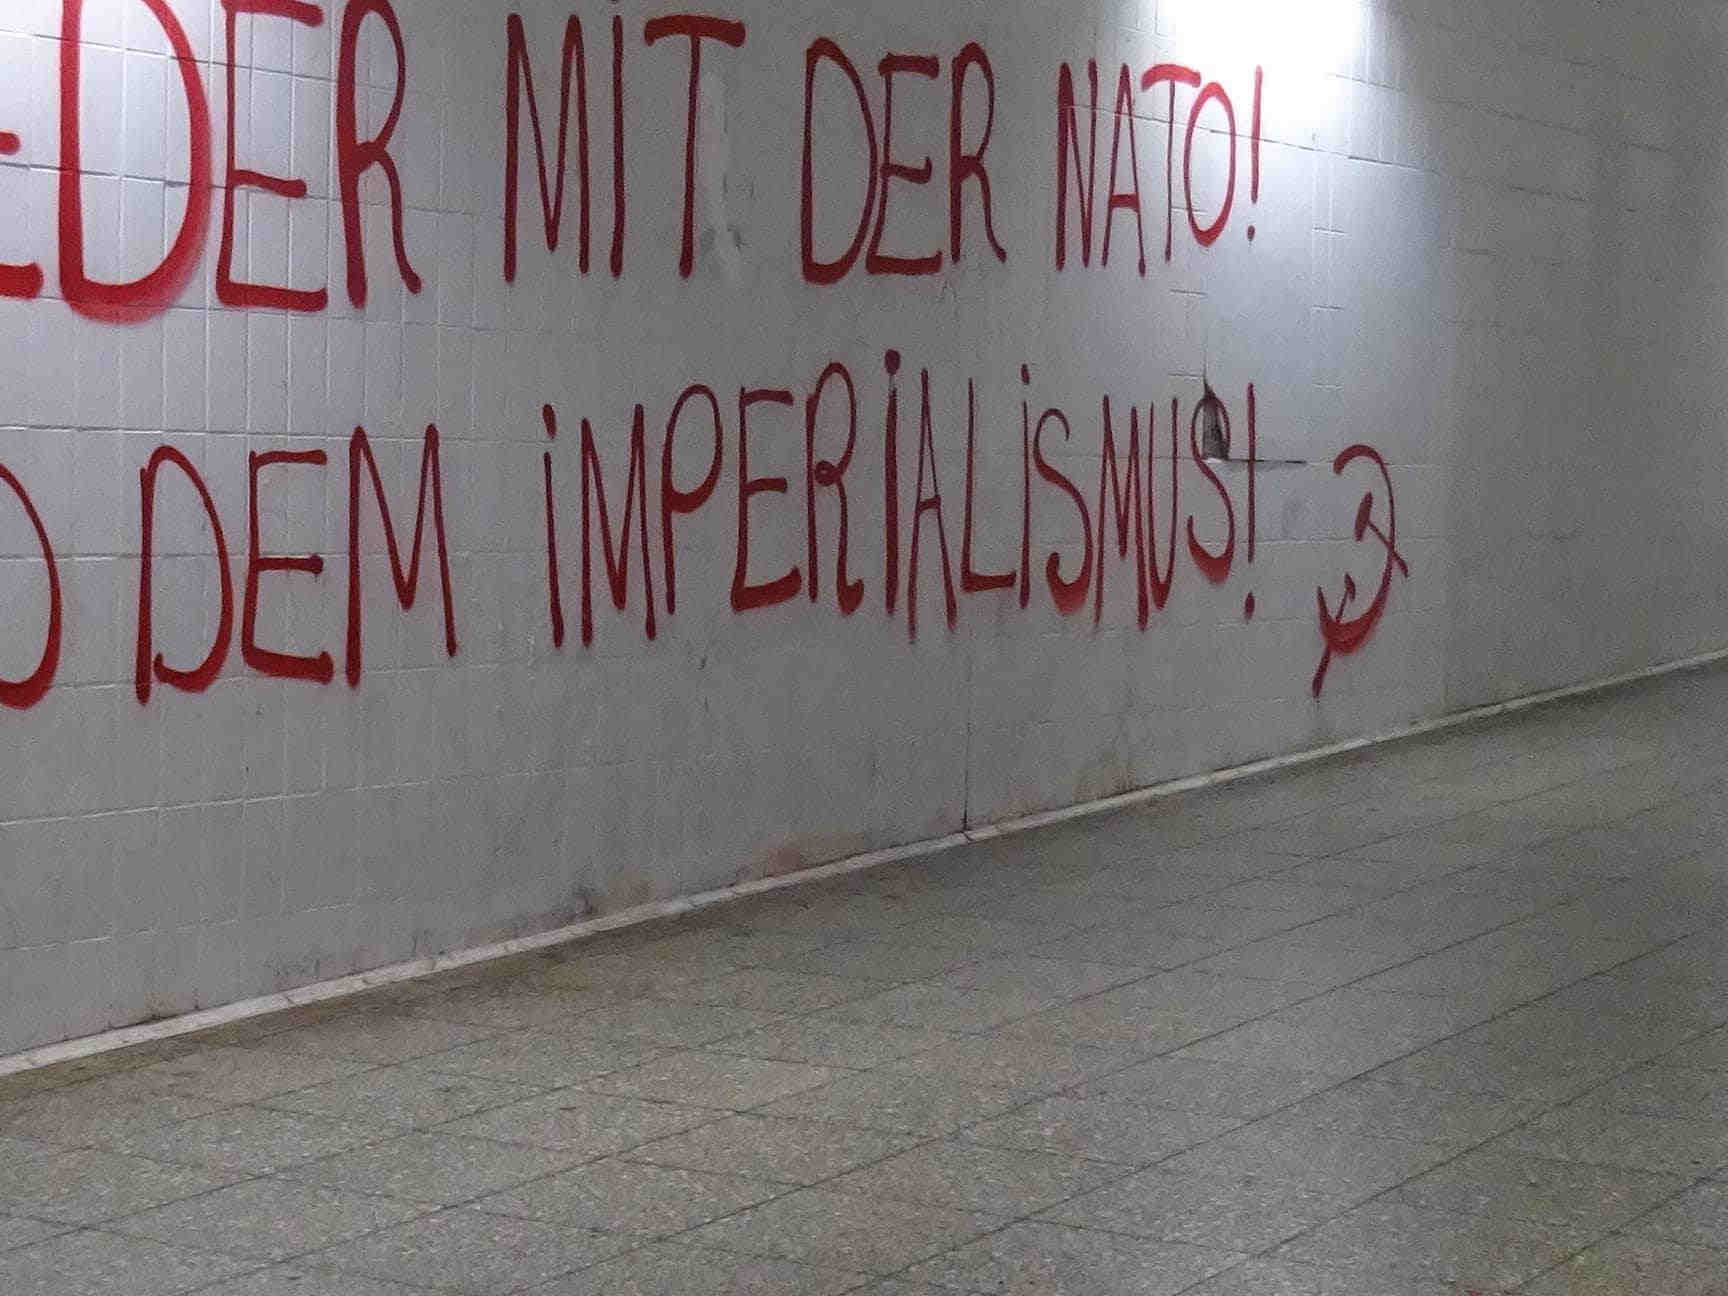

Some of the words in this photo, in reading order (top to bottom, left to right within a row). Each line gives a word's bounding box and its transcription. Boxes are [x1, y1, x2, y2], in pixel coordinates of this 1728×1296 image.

[800, 36, 1007, 286] DER
[1056, 58, 1265, 271] NATO!
[133, 422, 461, 706] DEM
